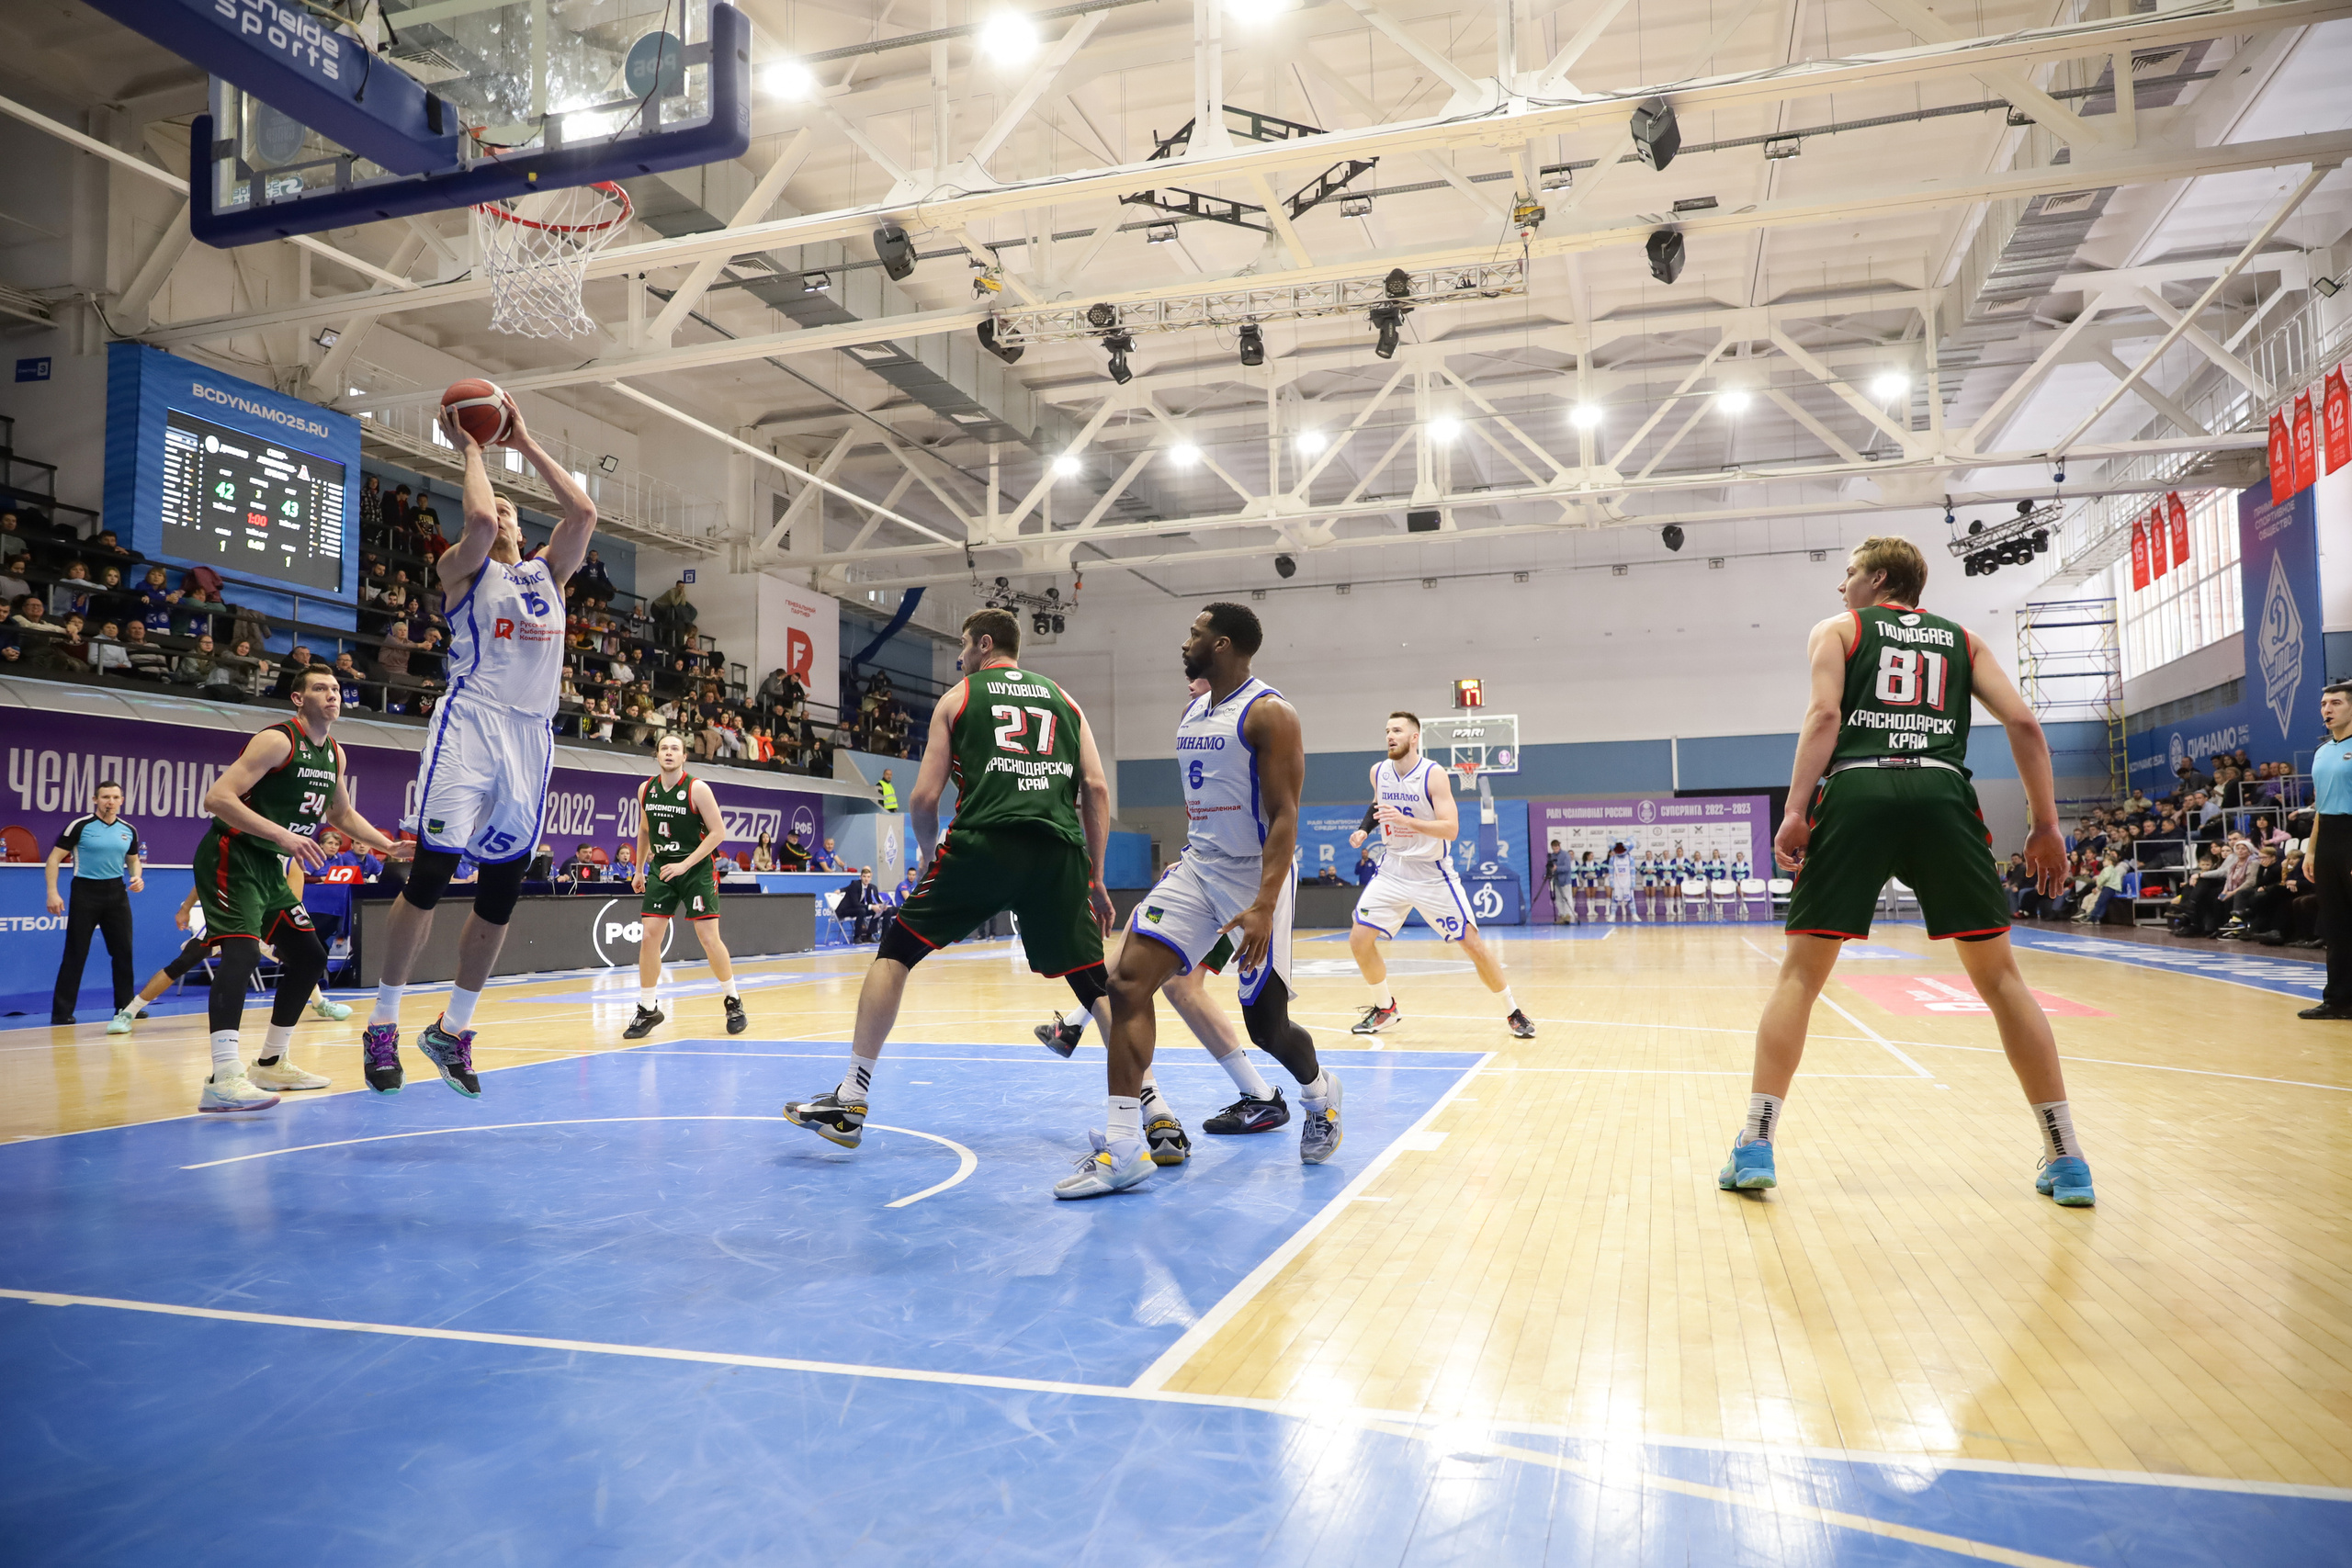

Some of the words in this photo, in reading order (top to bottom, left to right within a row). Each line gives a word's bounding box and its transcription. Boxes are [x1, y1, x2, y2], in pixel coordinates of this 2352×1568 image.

[193, 383, 328, 438] BCDYNAMO25.RU
[2328, 400, 2344, 431] 12
[2298, 421, 2311, 451] 15
[2275, 440, 2283, 465] 4
[215, 482, 235, 501] 42
[281, 501, 299, 518] 43
[247, 513, 268, 527] 1:00
[2173, 513, 2183, 536] 10
[2154, 528, 2161, 548] 8
[1875, 621, 1954, 648] ТЮЛЮБАЕВ
[1875, 646, 1948, 712] 81
[987, 682, 1051, 698] ШУХОВЦОВ
[1466, 690, 1481, 705] 17
[991, 705, 1057, 755] 27
[1452, 728, 1486, 739] PARI
[1176, 737, 1226, 750] ДИНАМО
[1889, 732, 1928, 750] КРАЙ
[2188, 727, 2237, 762] ДИНАМО
[1017, 775, 1049, 791] КРАЙ
[1188, 760, 1204, 790] 6
[299, 791, 326, 817] 24
[1382, 792, 1419, 802] ДИНАМО
[645, 803, 686, 816] ЛОКОМОТИВ
[1604, 807, 1633, 818] РОССИИ
[658, 821, 672, 838] 4
[795, 821, 812, 835] РФБ
[478, 825, 517, 853] 15
[693, 895, 705, 912] 4
[290, 905, 311, 926] 2
[605, 921, 643, 944] РФ
